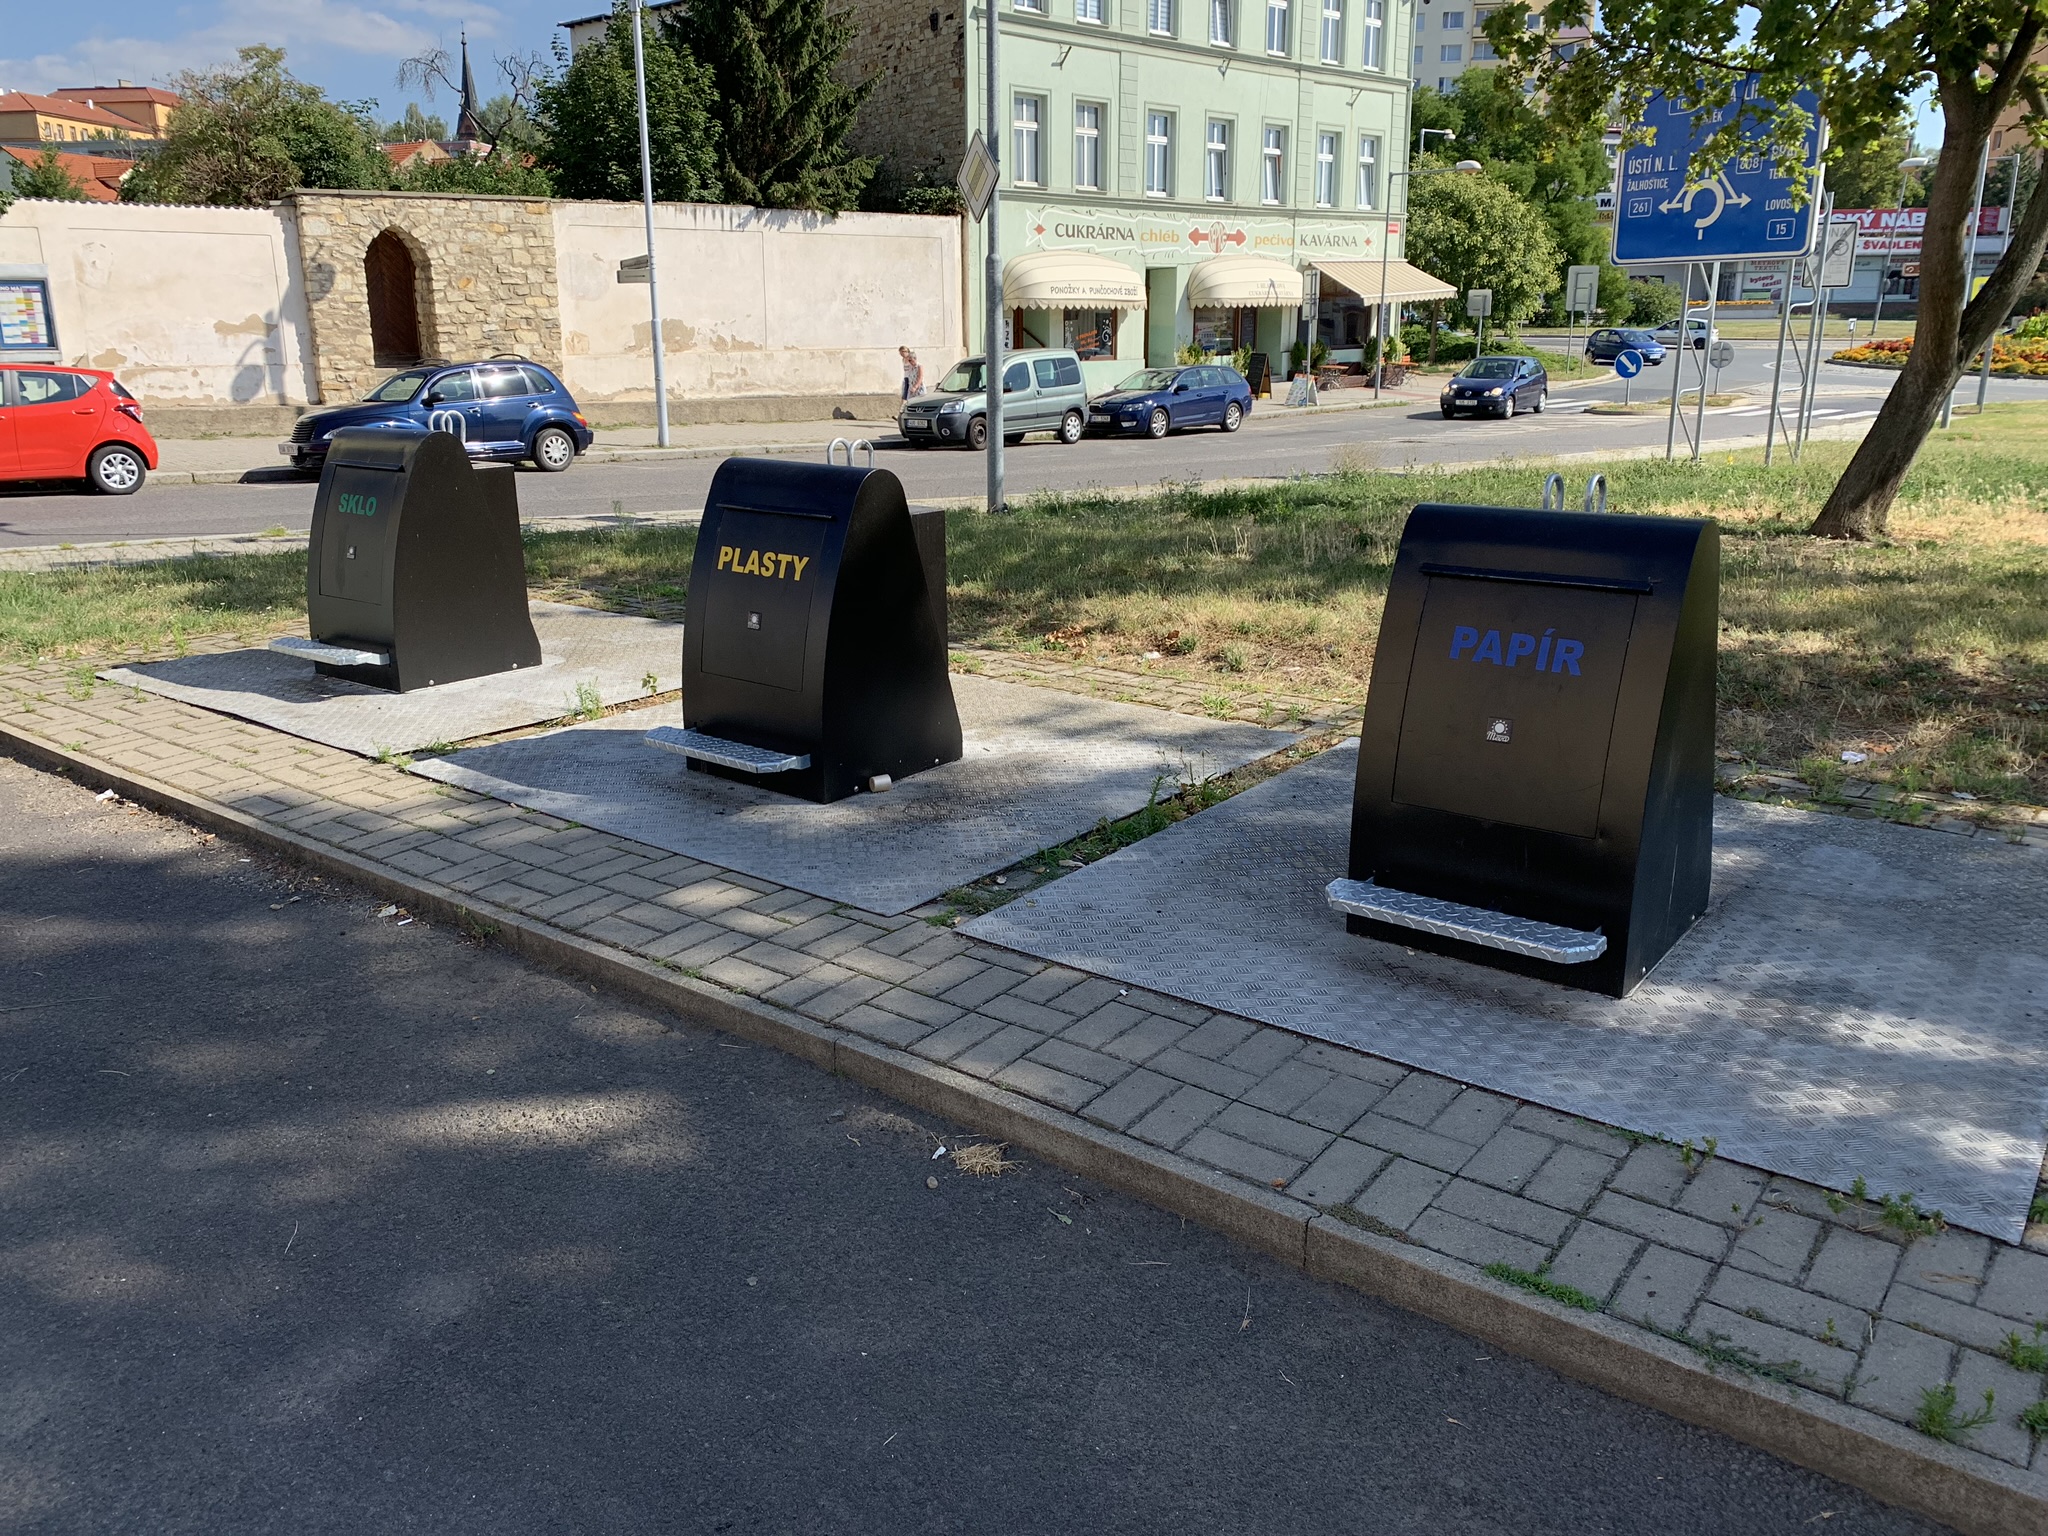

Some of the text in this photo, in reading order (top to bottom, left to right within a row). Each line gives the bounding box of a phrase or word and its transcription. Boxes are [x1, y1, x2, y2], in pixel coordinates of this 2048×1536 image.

[1628, 154, 1652, 175] ÚSTÍ
[1626, 177, 1669, 192] ŽALHOSTICE
[1633, 202, 1648, 213] 261
[1055, 223, 1358, 248] CUKRÁRNA chléb pečivo KAVÁRNA
[1775, 224, 1787, 236] 15
[1050, 283, 1080, 295] PONOŽKY
[338, 493, 377, 517] SKLO
[717, 545, 810, 581] PLASTY
[1448, 625, 1585, 677] PAPÍR
